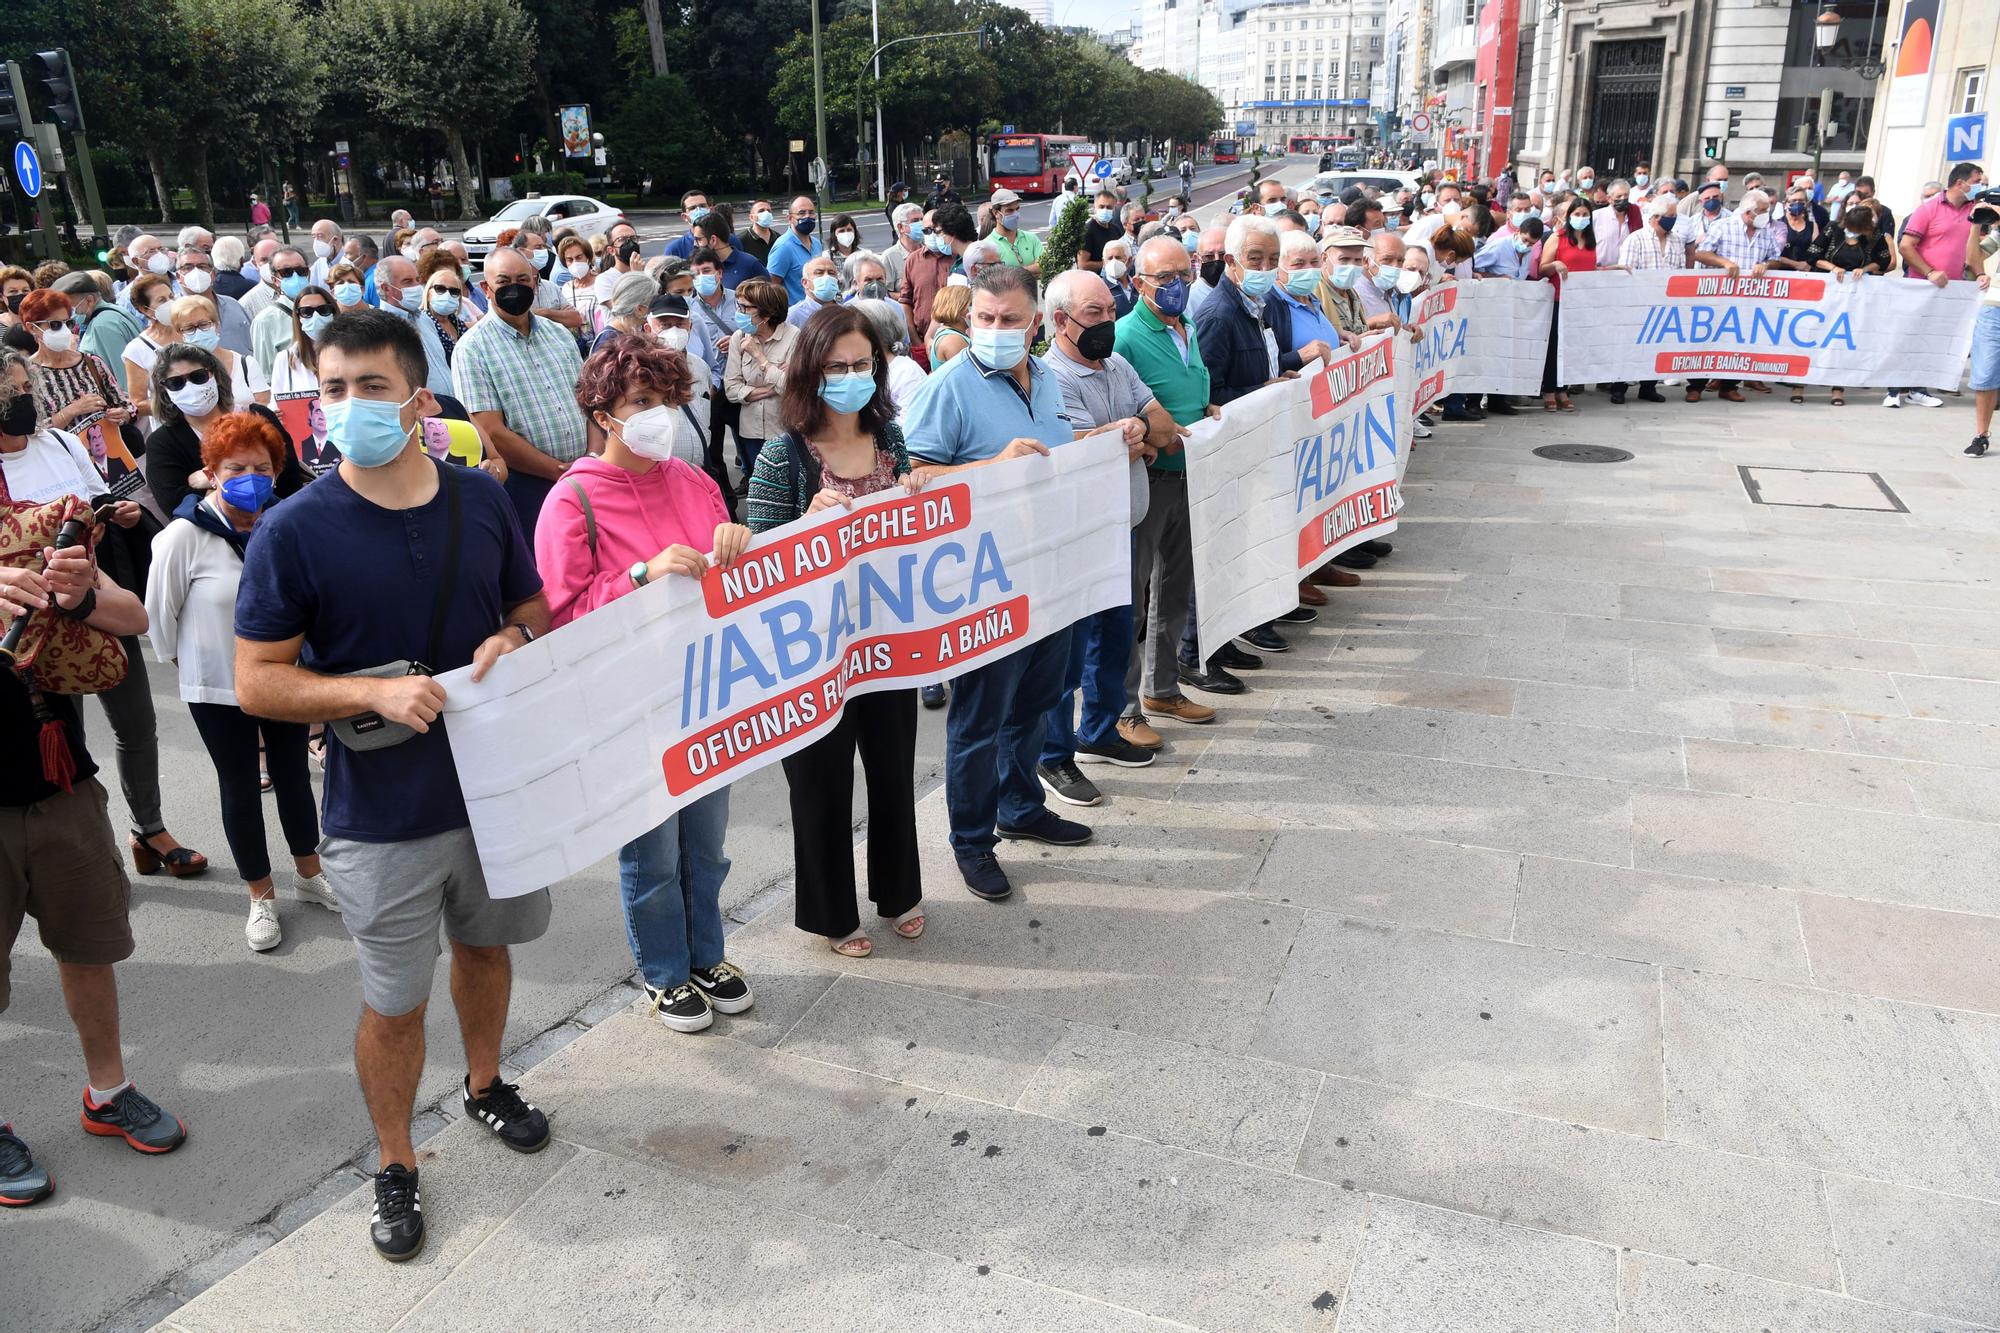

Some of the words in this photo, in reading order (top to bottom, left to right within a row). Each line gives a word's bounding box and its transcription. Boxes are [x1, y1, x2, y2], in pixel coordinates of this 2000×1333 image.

[1953, 124, 1982, 153] N
[1696, 277, 1719, 296] NON
[1736, 277, 1772, 298] PECHE
[1772, 279, 1790, 298] DA
[1671, 355, 1702, 371] OFICINA
[1703, 355, 1716, 370] DE
[1716, 353, 1751, 371] BAIÑAS
[1326, 364, 1349, 405] NON
[1322, 499, 1359, 547] OFICINA
[1357, 491, 1378, 527] DE
[720, 550, 787, 605] NON
[794, 534, 833, 578] AO
[838, 505, 918, 559] PECHE
[923, 495, 956, 532] DA
[686, 690, 819, 777] OFICINAS
[822, 641, 893, 712] RURAIS
[937, 631, 954, 662] A
[958, 607, 1014, 655] BAÑA
